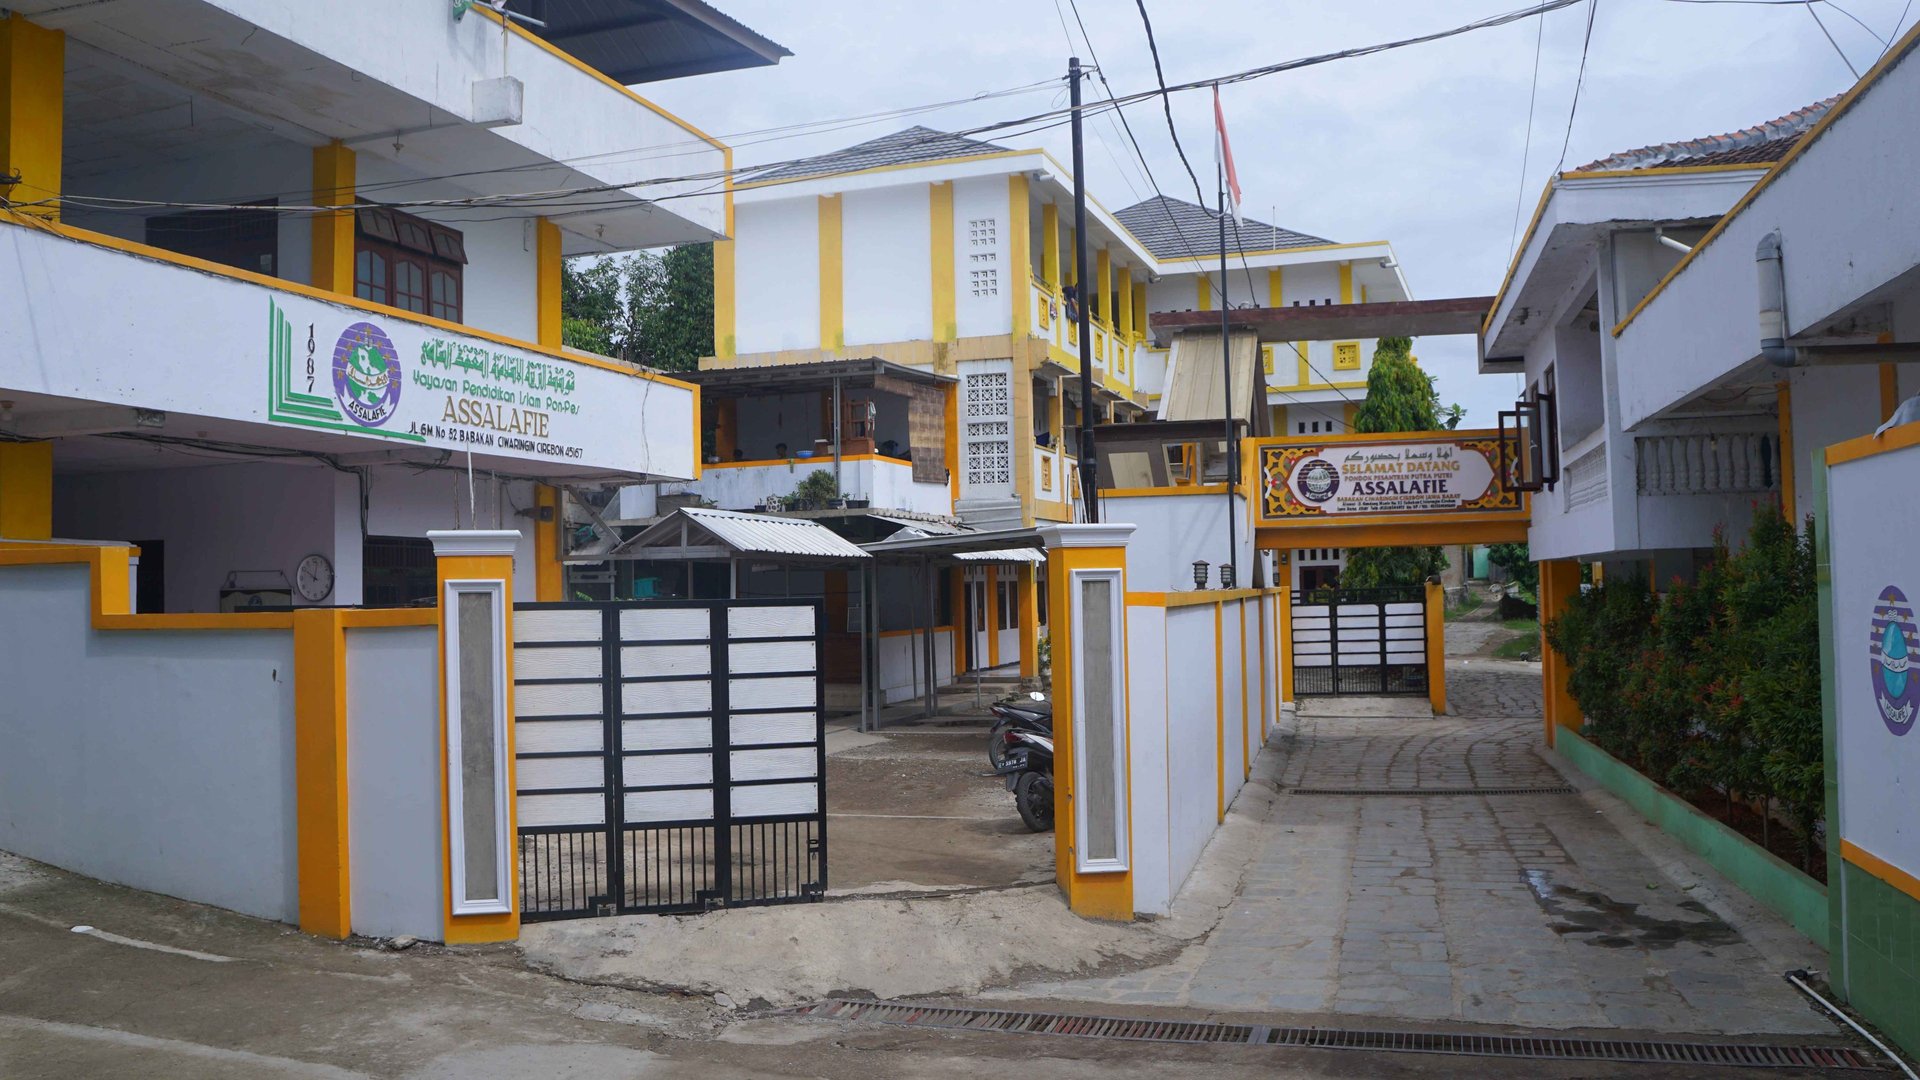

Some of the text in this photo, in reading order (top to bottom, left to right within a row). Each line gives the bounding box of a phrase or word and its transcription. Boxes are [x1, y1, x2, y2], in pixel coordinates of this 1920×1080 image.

[305, 322, 316, 393] 1987
[413, 369, 458, 392] Yayasan
[463, 379, 515, 404] Pendidikan
[519, 390, 541, 409] Islam
[546, 396, 580, 416] Pon-Pes
[348, 400, 388, 421] ASSALAFIE
[441, 395, 550, 438] ASSALAFIE
[448, 427, 458, 441] 52
[459, 429, 494, 447] BABAKAN
[497, 435, 536, 453] CIWARINGIN
[536, 442, 565, 457] CIREBON
[565, 446, 584, 460] 45167
[1341, 460, 1461, 475] SELAMAT DATANG
[1410, 472, 1432, 480] PUTRA
[1351, 479, 1449, 496] ASSALAFIE
